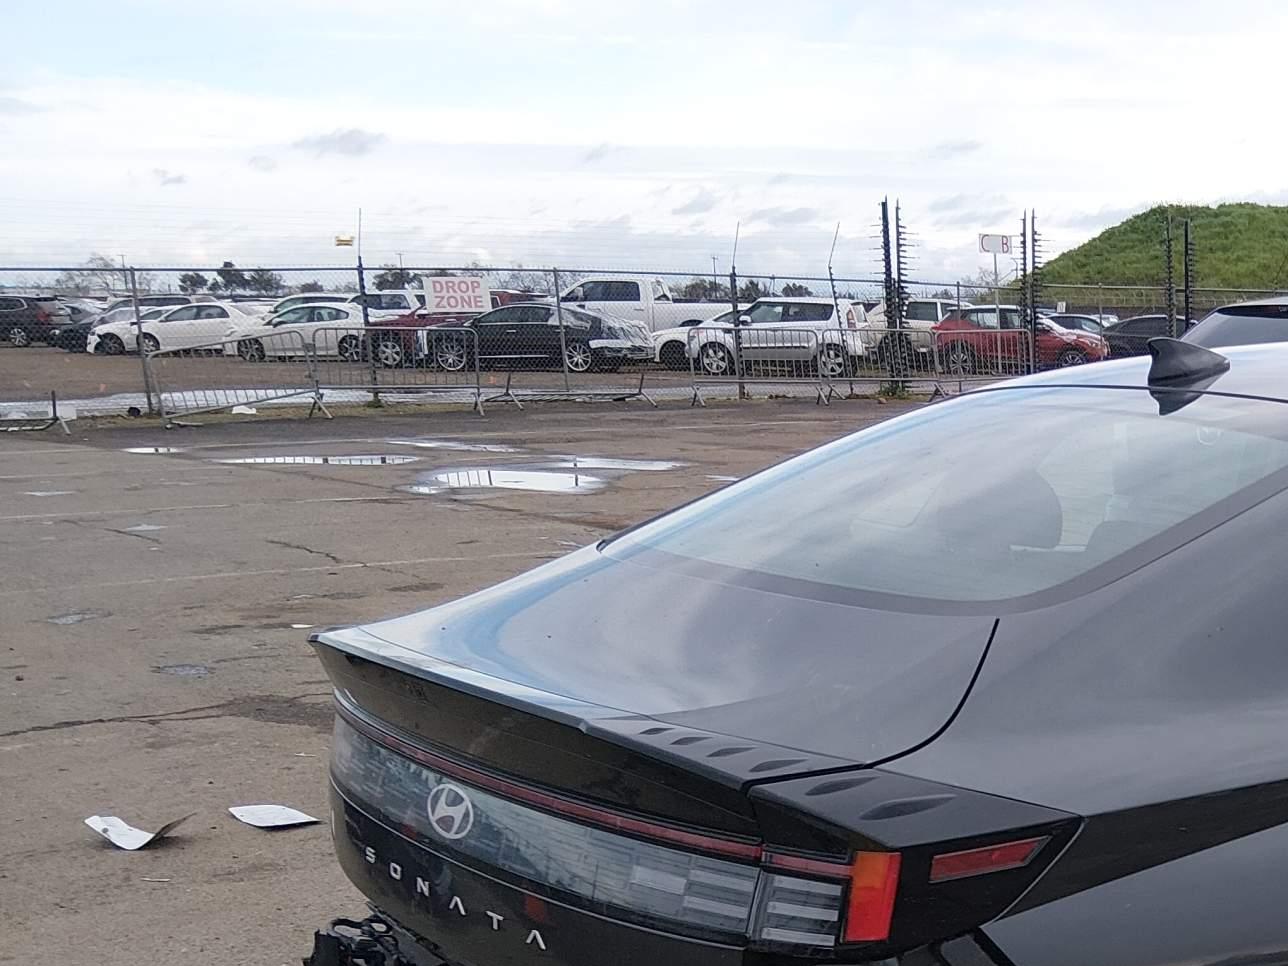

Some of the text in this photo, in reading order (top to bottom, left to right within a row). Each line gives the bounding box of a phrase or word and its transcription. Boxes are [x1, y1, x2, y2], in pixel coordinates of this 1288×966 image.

[1002, 236, 1010, 254] B
[431, 280, 481, 294] DROP
[434, 295, 485, 309] ZONE
[365, 846, 547, 950] SONATA
